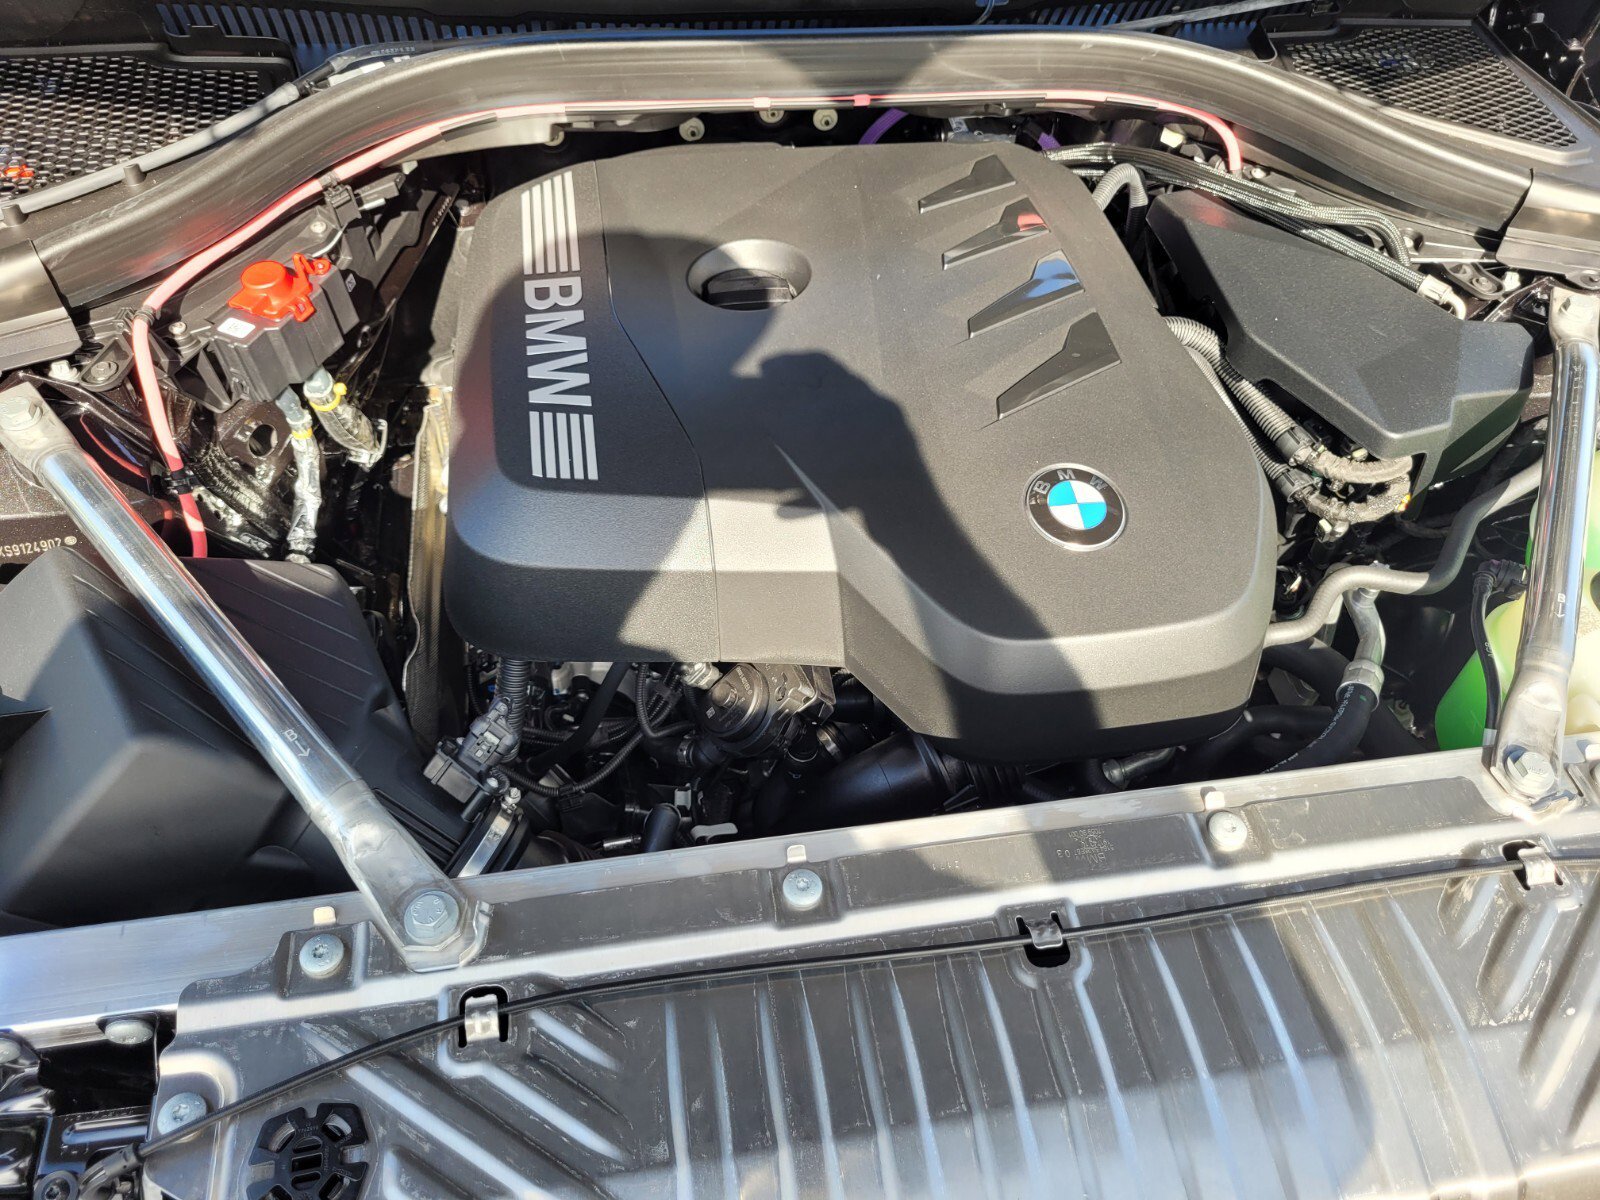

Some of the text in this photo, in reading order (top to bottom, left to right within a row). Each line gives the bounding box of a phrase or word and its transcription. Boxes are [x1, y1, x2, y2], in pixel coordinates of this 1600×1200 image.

[523, 276, 592, 407] BMW
[1033, 469, 1109, 495] BMW
[283, 729, 298, 742] B
